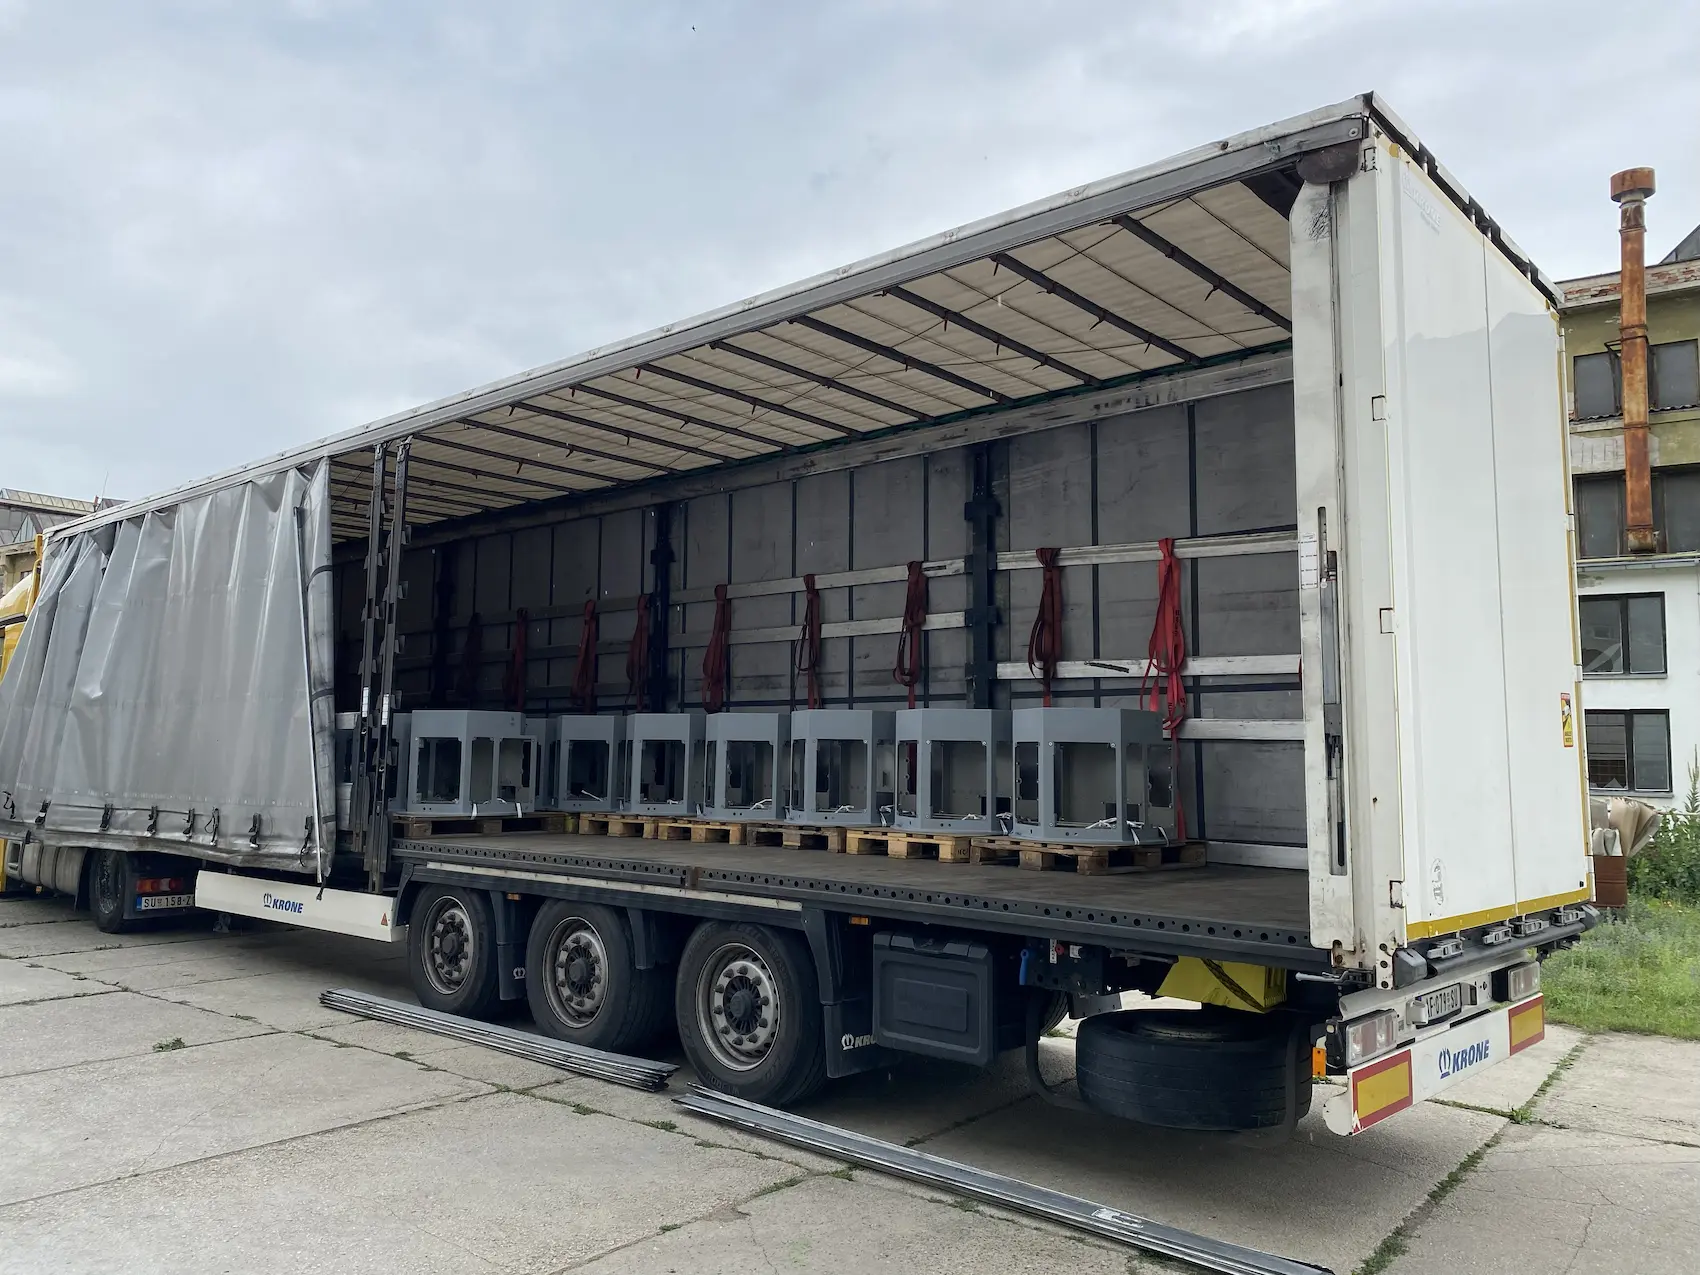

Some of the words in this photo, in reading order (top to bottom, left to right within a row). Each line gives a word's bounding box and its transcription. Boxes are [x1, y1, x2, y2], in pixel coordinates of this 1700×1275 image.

[144, 898, 156, 908] SU
[165, 896, 195, 907] 158-Z
[272, 898, 304, 914] KRONE
[1452, 1039, 1490, 1074] KRONE
